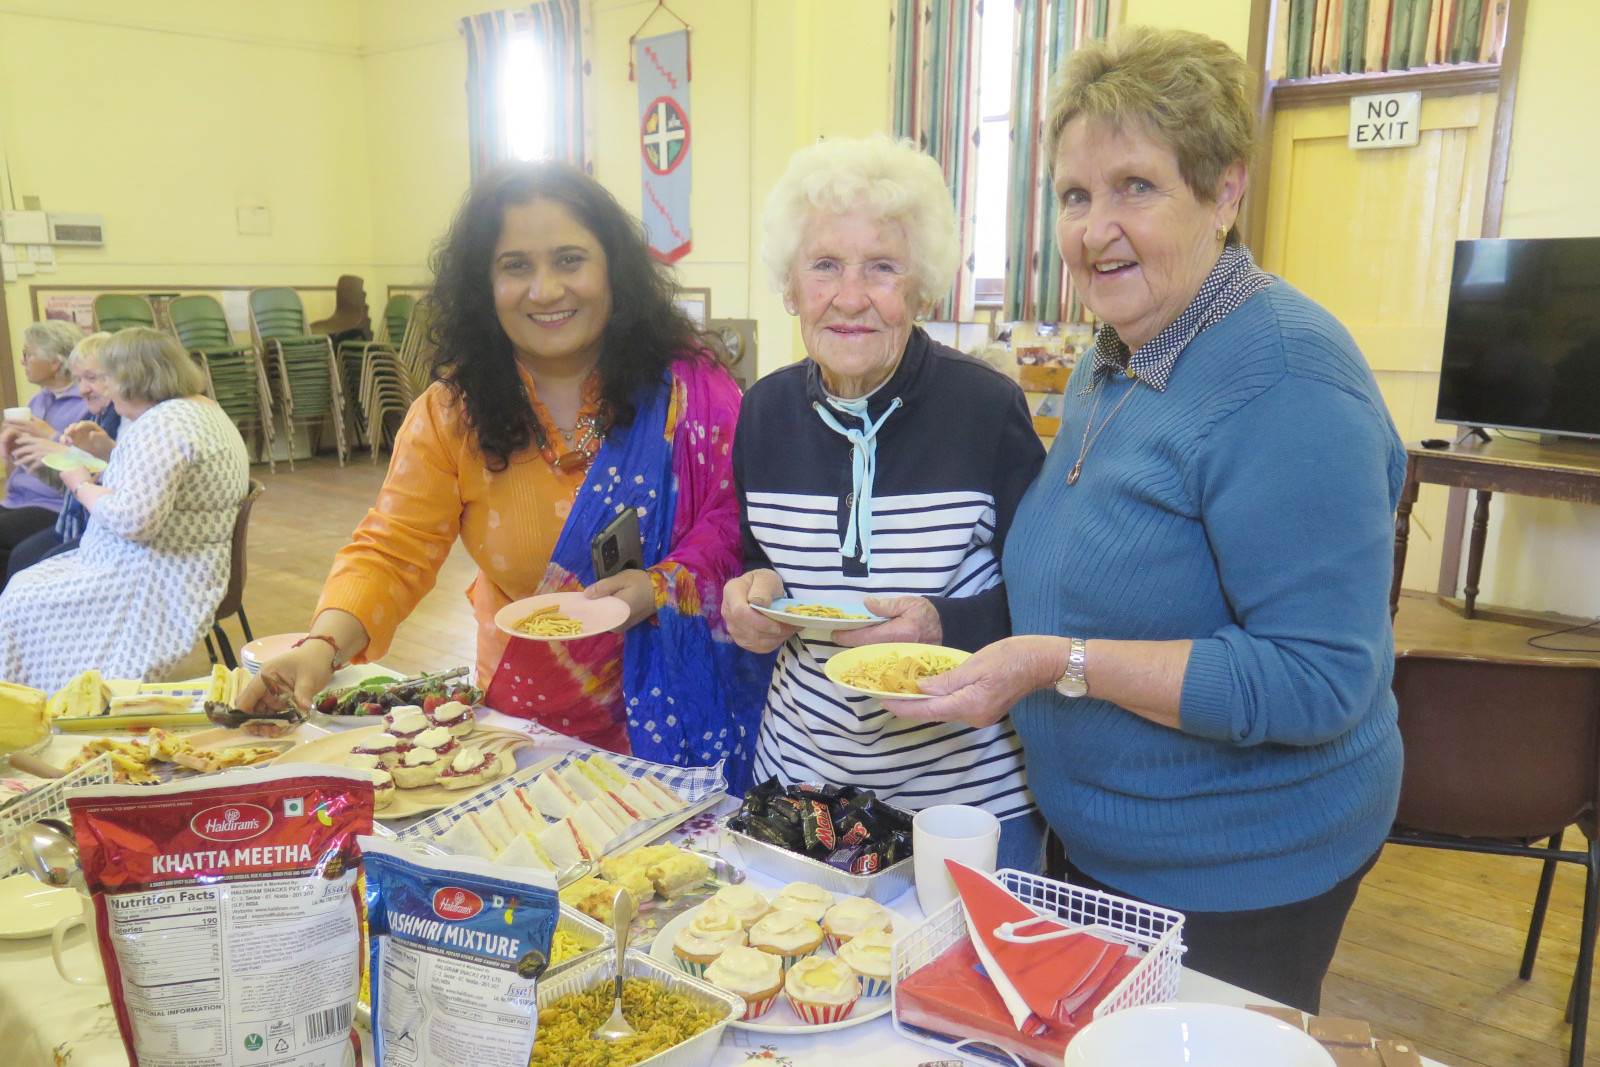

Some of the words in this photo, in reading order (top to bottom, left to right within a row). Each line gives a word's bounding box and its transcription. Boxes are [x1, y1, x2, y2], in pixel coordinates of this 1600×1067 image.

[1367, 99, 1400, 119] NO
[1356, 121, 1409, 143] EXIT
[205, 818, 260, 833] Haldiram's
[811, 800, 836, 850] Mars
[842, 821, 869, 845] ars
[152, 850, 231, 874] KHATTA
[234, 844, 312, 867] MEETHA
[263, 886, 288, 894] SNACKS
[110, 894, 176, 909] Nutrition
[180, 891, 216, 902] Facts
[202, 917, 218, 925] 190
[387, 910, 445, 942] KASHMIRI
[443, 925, 521, 959] MIXTURE
[459, 968, 479, 978] SNACKS
[167, 1004, 222, 1016] INFORMATION
